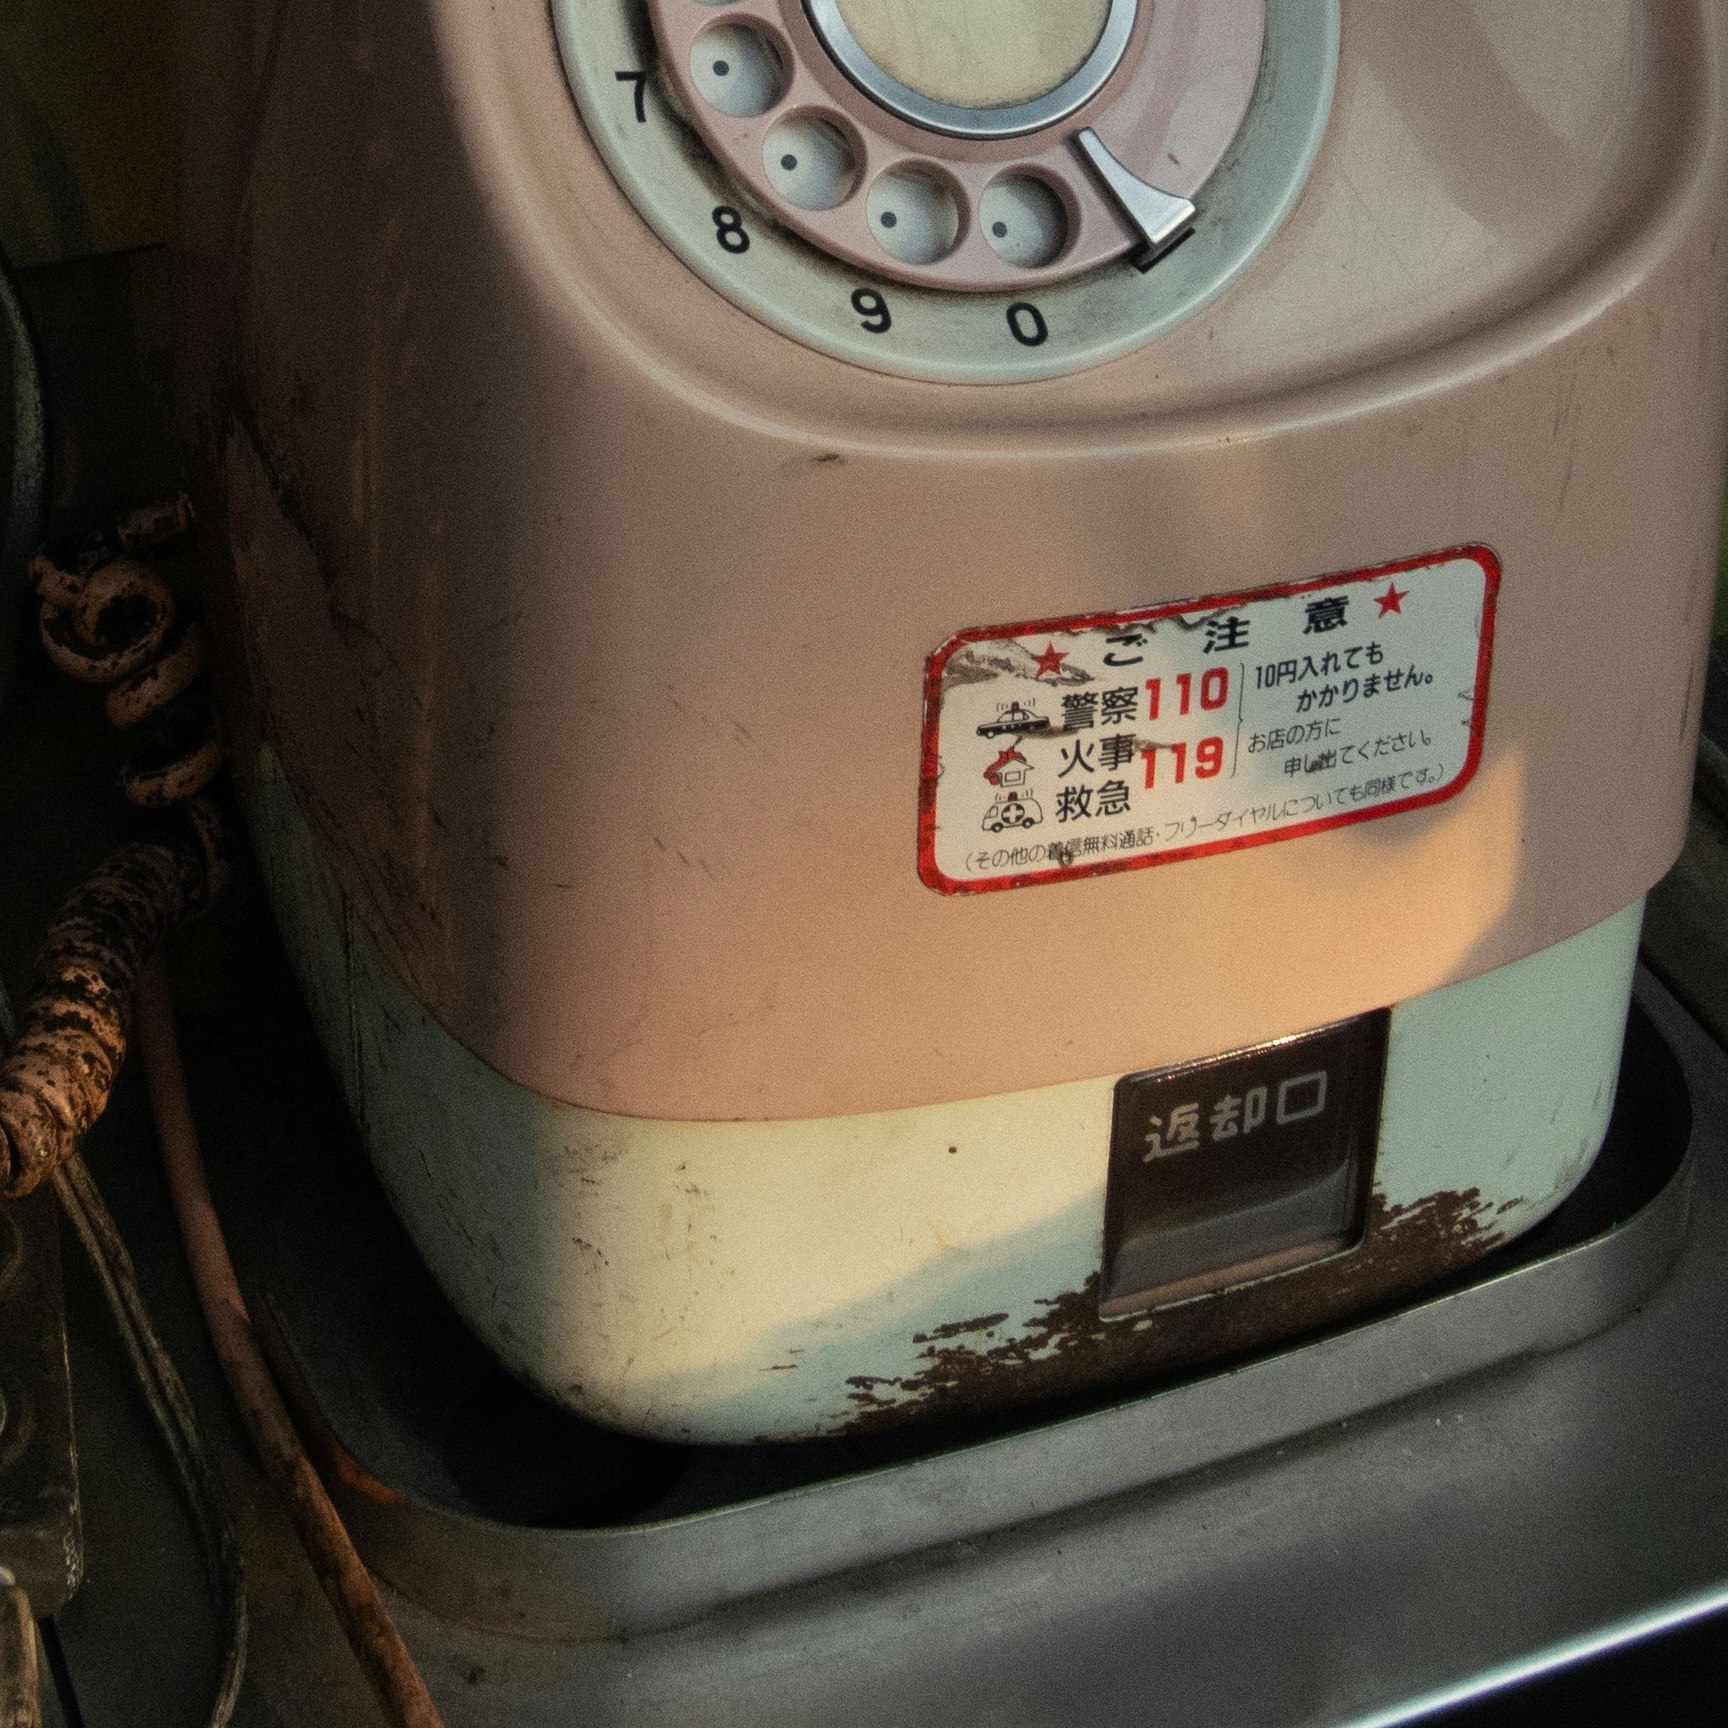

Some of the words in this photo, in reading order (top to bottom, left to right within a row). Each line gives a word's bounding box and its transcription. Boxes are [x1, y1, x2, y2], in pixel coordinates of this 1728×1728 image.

[615, 70, 648, 124] 7
[711, 205, 751, 255] 8
[849, 286, 893, 335] 9
[1005, 300, 1049, 347] 0
[1255, 641, 1384, 690] 10円入れても
[1296, 665, 1434, 713] かかりません。
[1061, 688, 1139, 733] 警察
[1145, 667, 1229, 721] 110
[1248, 717, 1341, 754] お店の方に
[1059, 733, 1137, 779] 火事
[1141, 736, 1224, 790] 119
[1055, 780, 1132, 824] 救急
[1142, 1071, 1328, 1163] 返却口
